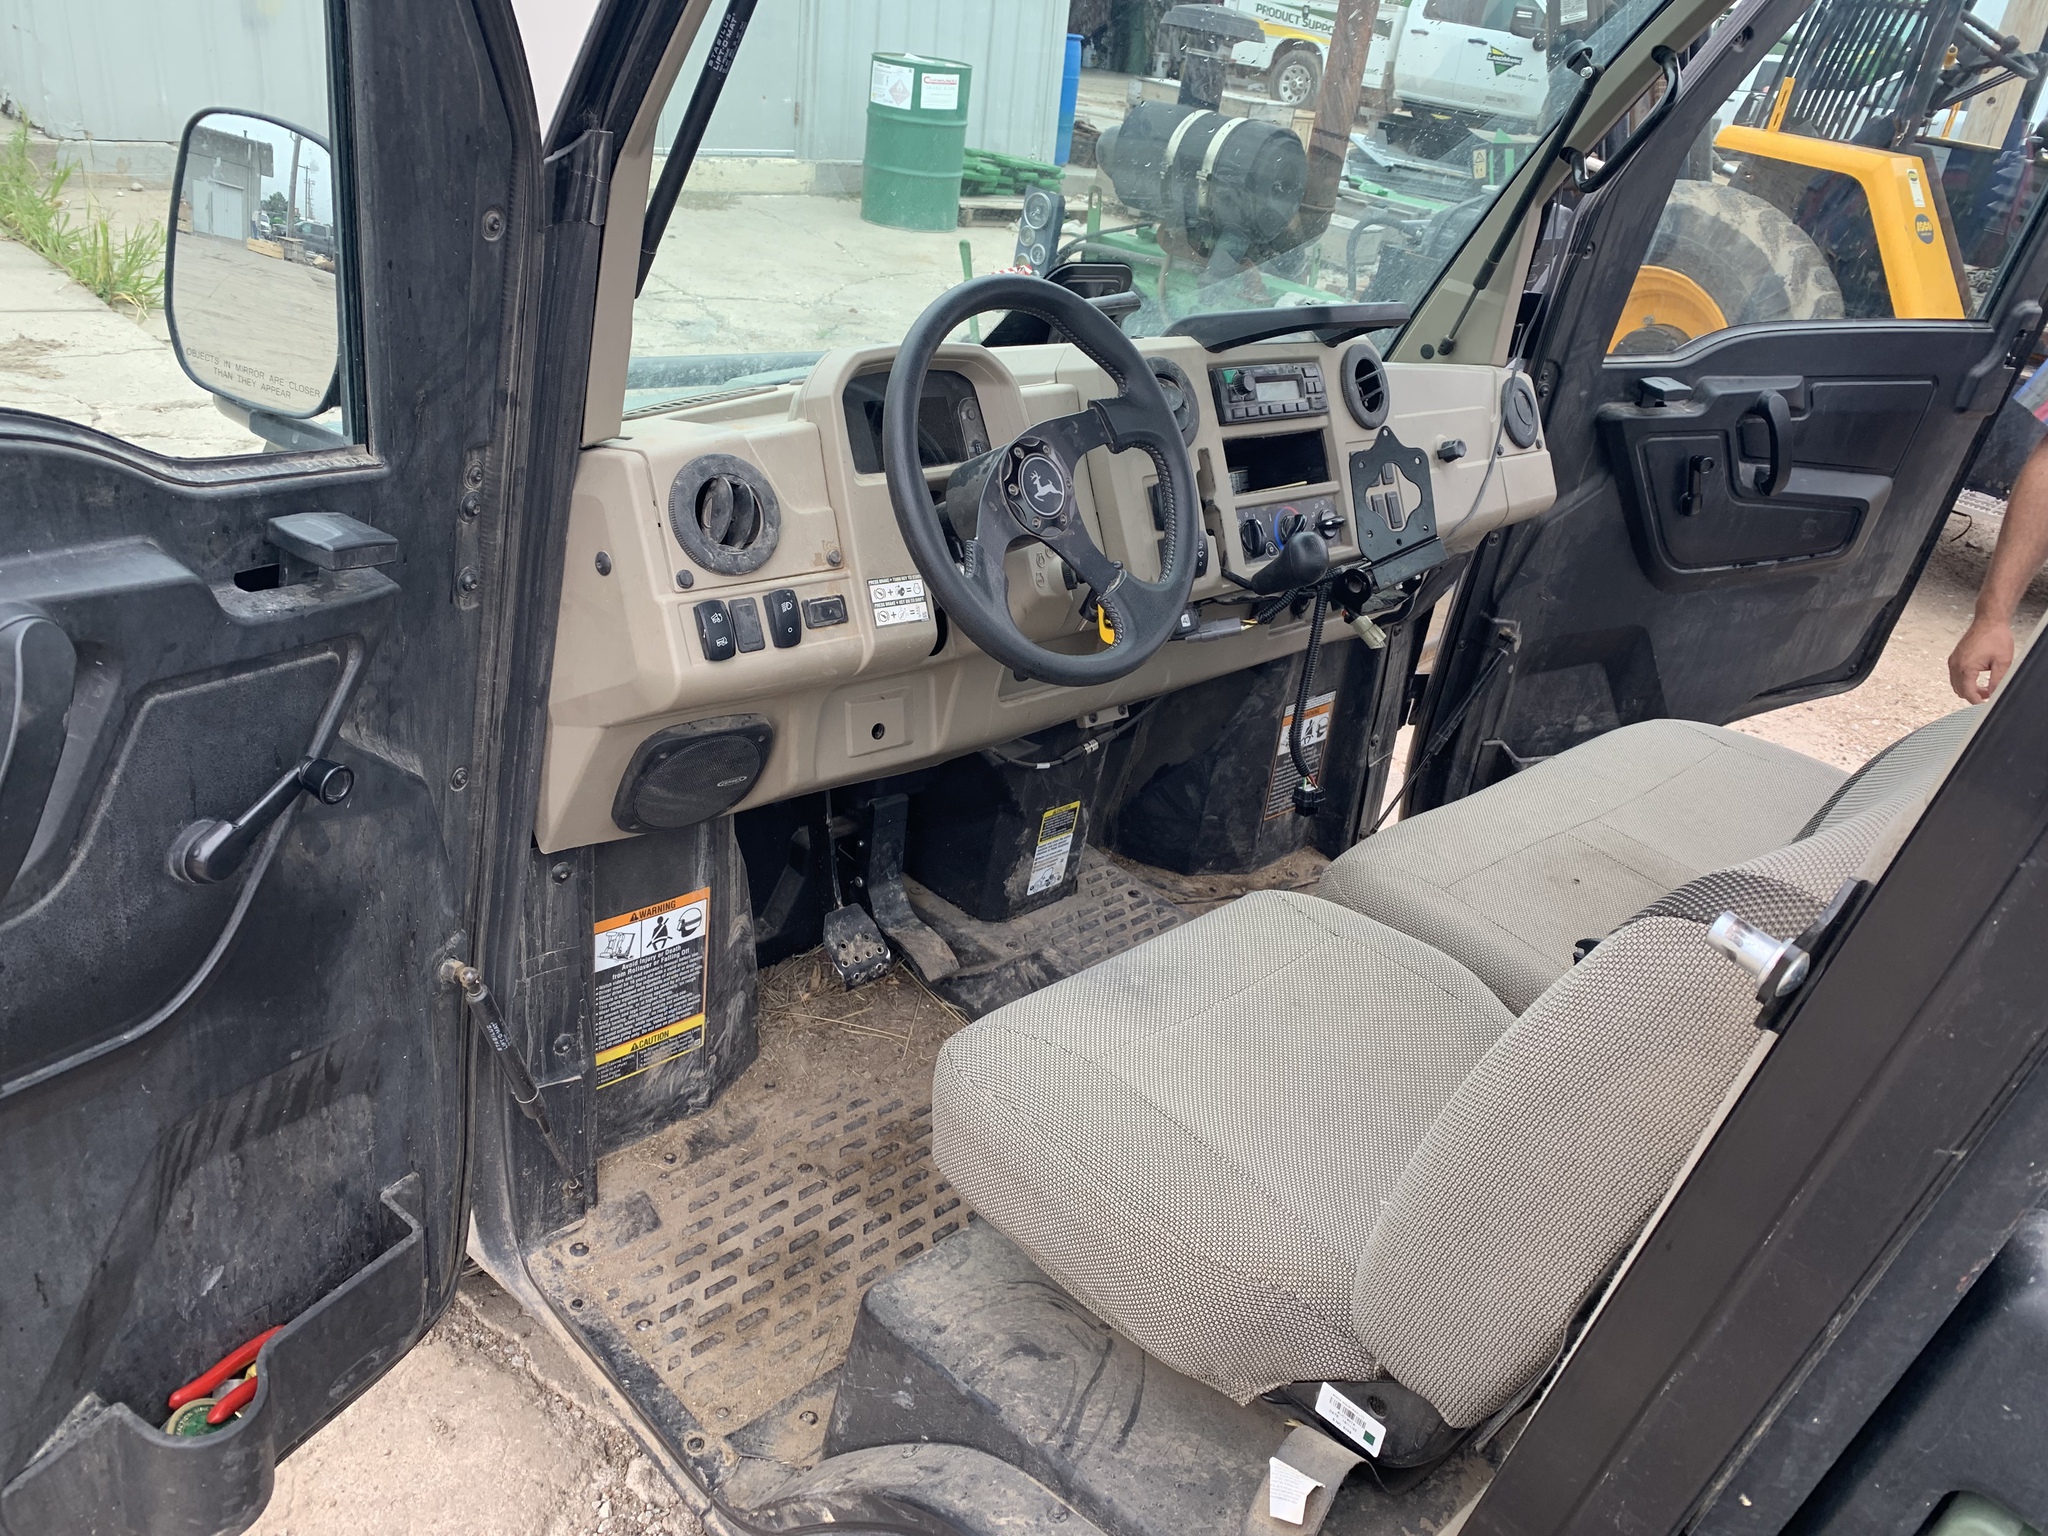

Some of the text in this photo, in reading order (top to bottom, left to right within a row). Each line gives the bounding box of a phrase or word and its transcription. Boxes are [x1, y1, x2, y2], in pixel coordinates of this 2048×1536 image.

[1256, 3, 1336, 34] PRODUCT SUPPO
[708, 13, 732, 67] STABILUS
[186, 347, 321, 398] OBJECTS IN MIRROR ARE CLOSER
[213, 367, 292, 399] THAN THEY APPEAR
[639, 900, 676, 919] WARNING
[612, 947, 689, 980] from Rollover or Falling Off
[621, 944, 681, 971] Avoid Injury or Death
[639, 1030, 669, 1049] CAUTION
